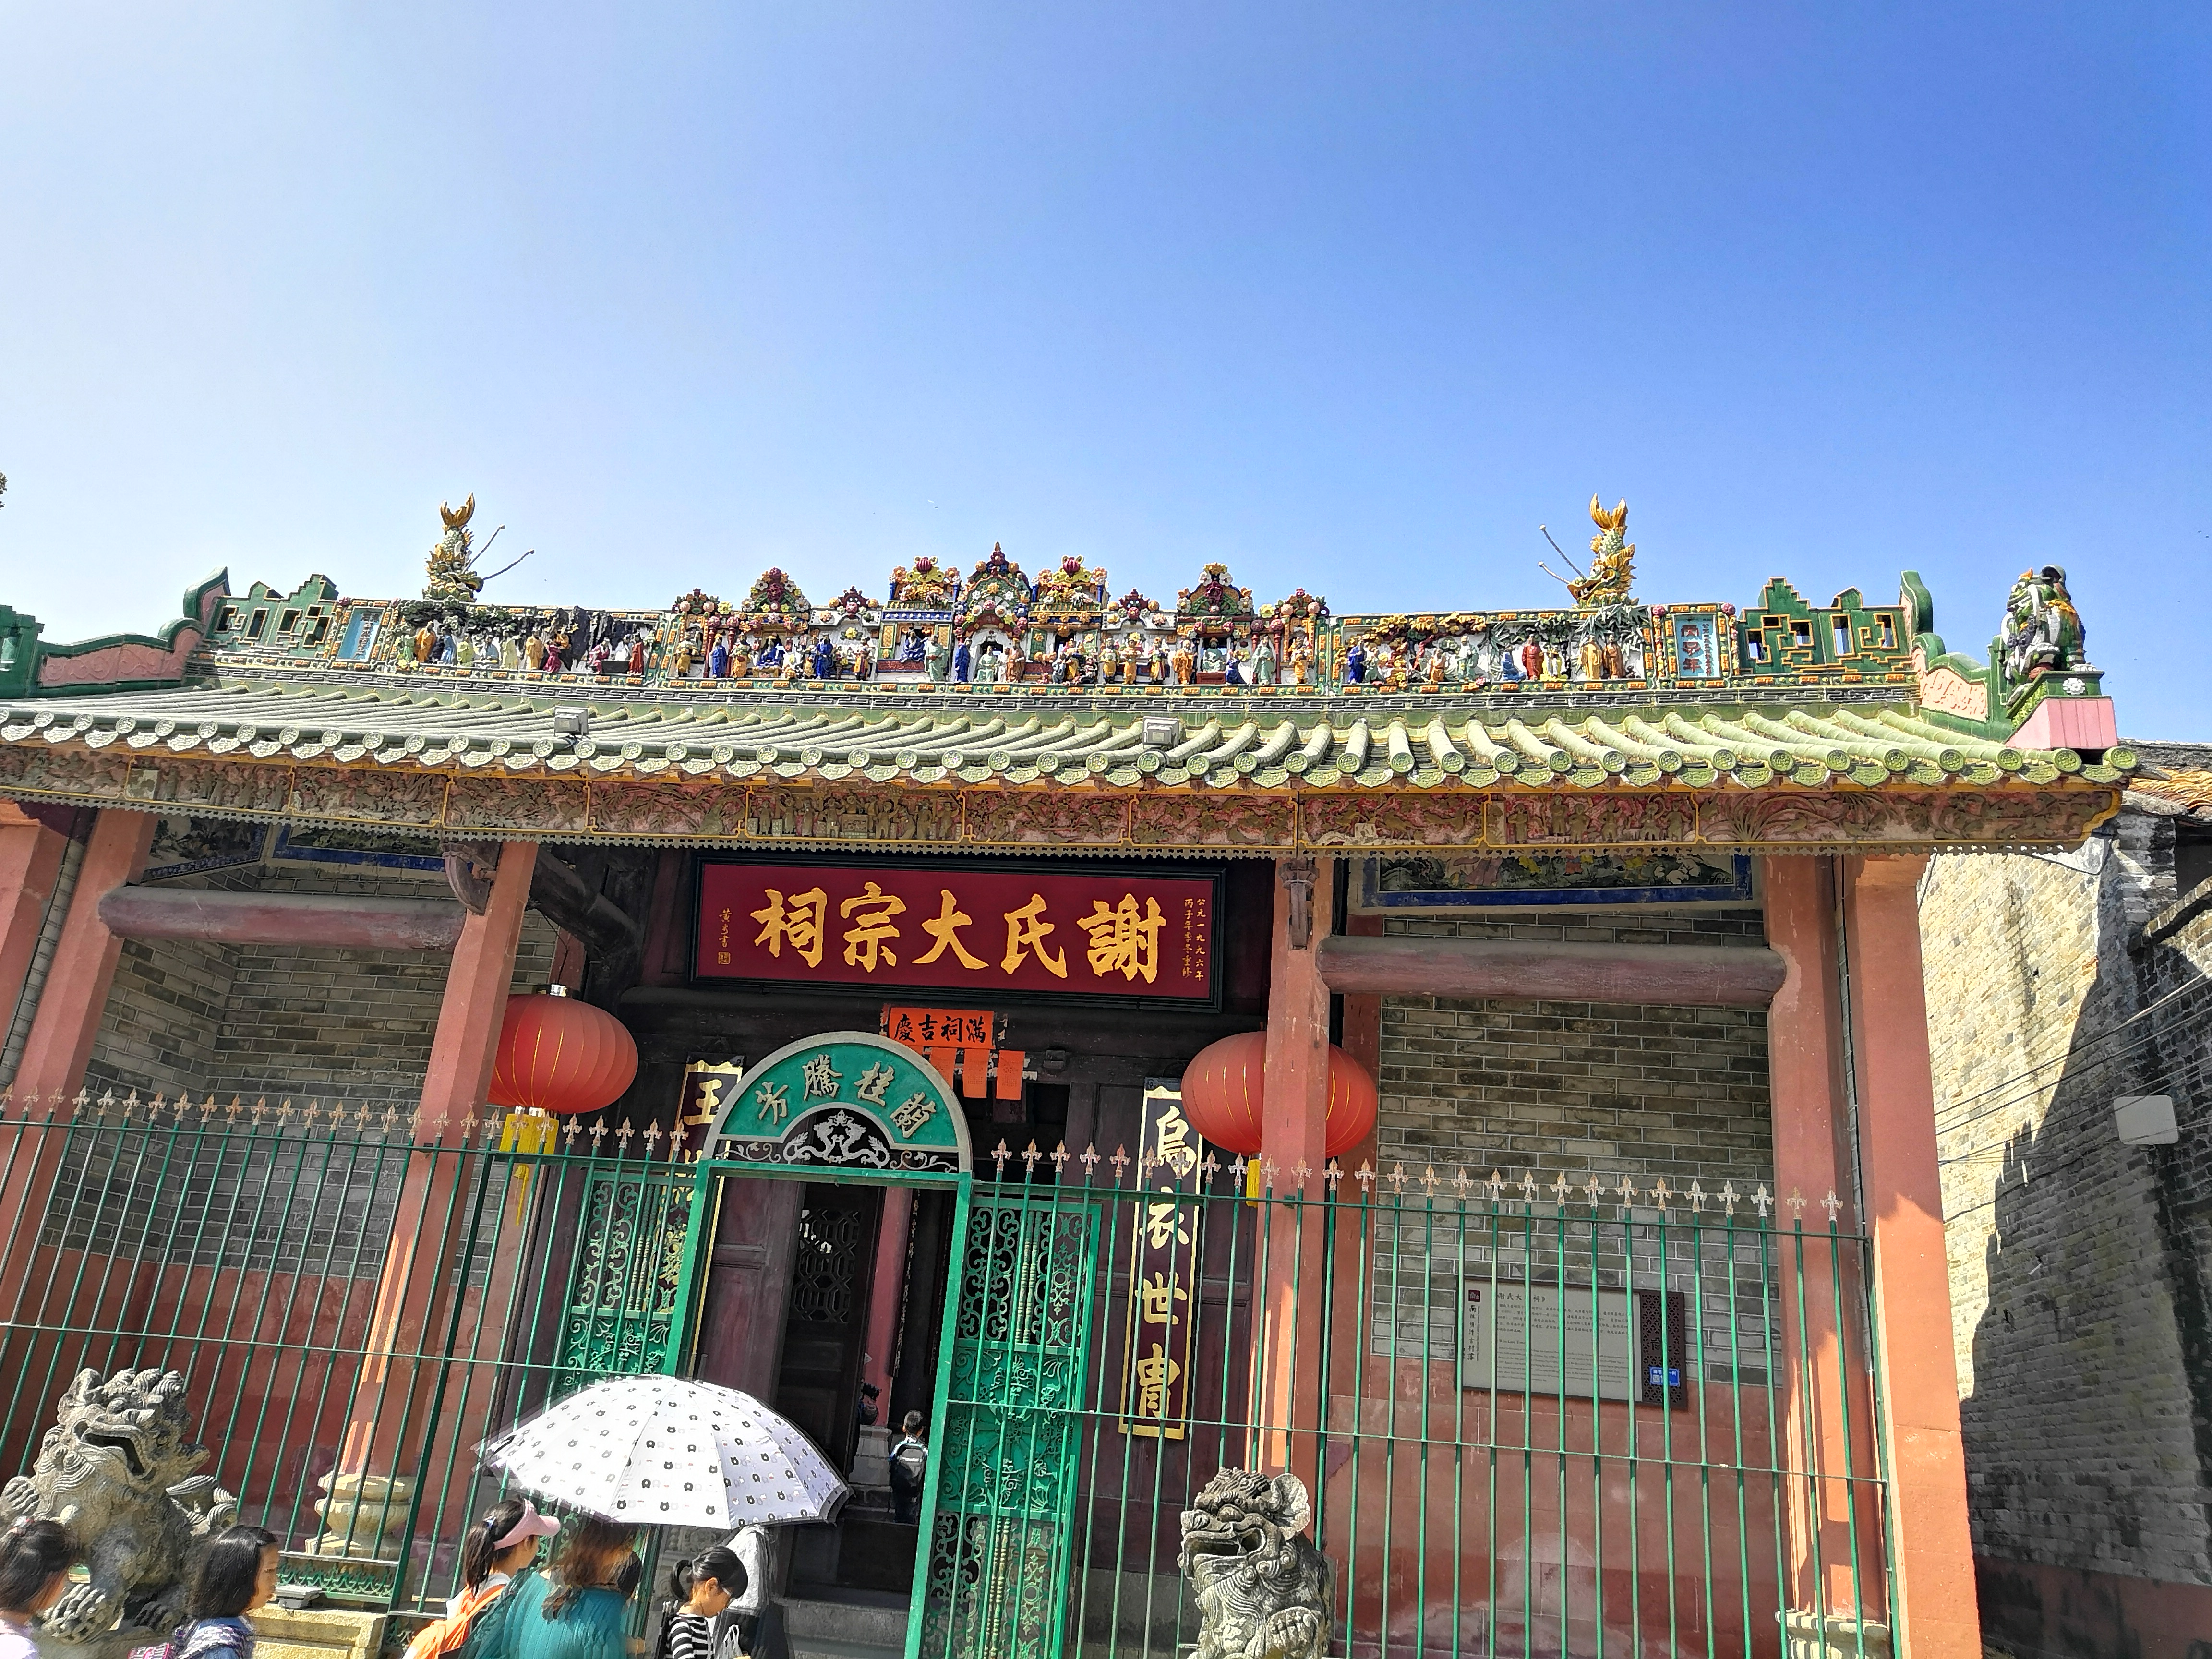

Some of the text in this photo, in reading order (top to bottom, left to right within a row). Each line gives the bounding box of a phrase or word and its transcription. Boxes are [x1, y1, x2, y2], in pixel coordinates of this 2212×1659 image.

[750, 881, 1166, 983] 謝氏大宗祠
[1194, 898, 1206, 981] 公元一九九六年
